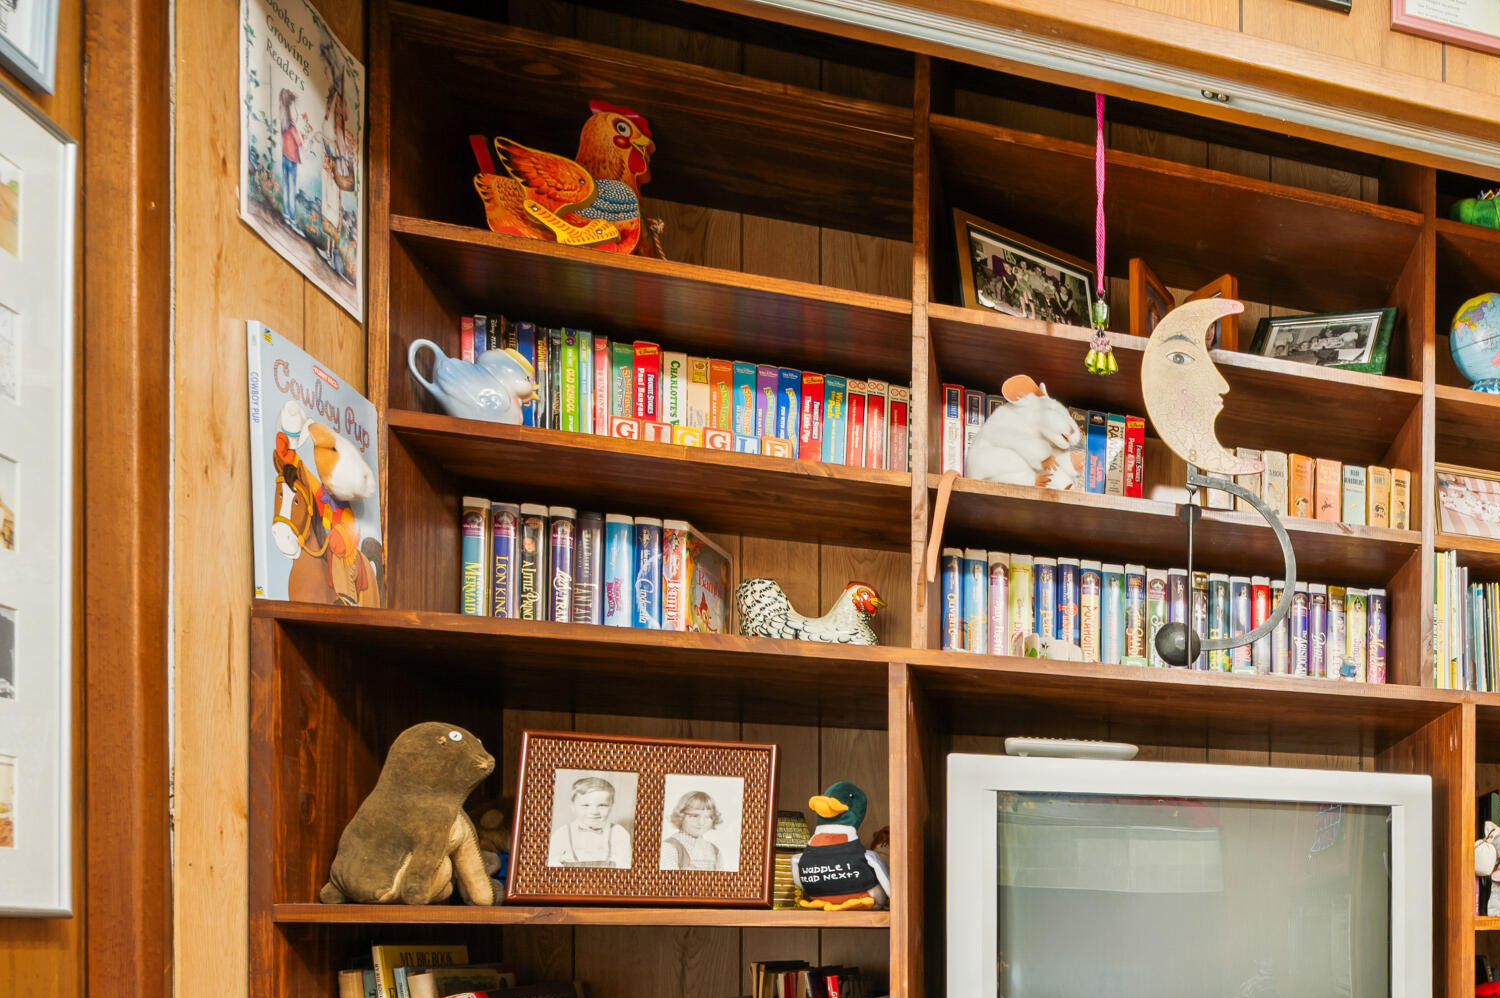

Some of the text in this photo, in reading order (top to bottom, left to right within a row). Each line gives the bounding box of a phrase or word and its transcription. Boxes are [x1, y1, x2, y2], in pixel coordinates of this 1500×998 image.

[266, 0, 314, 50] ooks for
[266, 14, 309, 76] Growing
[266, 37, 305, 91] Readers
[250, 371, 261, 424] COWBOY PUP
[566, 368, 575, 384] OLD
[566, 384, 575, 413] SCHOOL
[637, 368, 645, 417] Paul Bunyan
[669, 360, 681, 419] CHARLOTTE'S
[273, 359, 341, 434] Cowboy
[345, 406, 370, 453] Pup
[801, 396, 812, 443] Three Little Pigs
[834, 391, 843, 418] Winnie
[1126, 473, 1134, 487] Wolf
[462, 561, 481, 614] MERMAID
[494, 555, 509, 618] LION KING
[521, 568, 536, 592] LITTLE
[635, 578, 655, 624] Cinderella
[666, 579, 681, 622] Bambi
[1083, 605, 1098, 661] POCAHONTA
[400, 951, 452, 967] MY BIG BOOK
